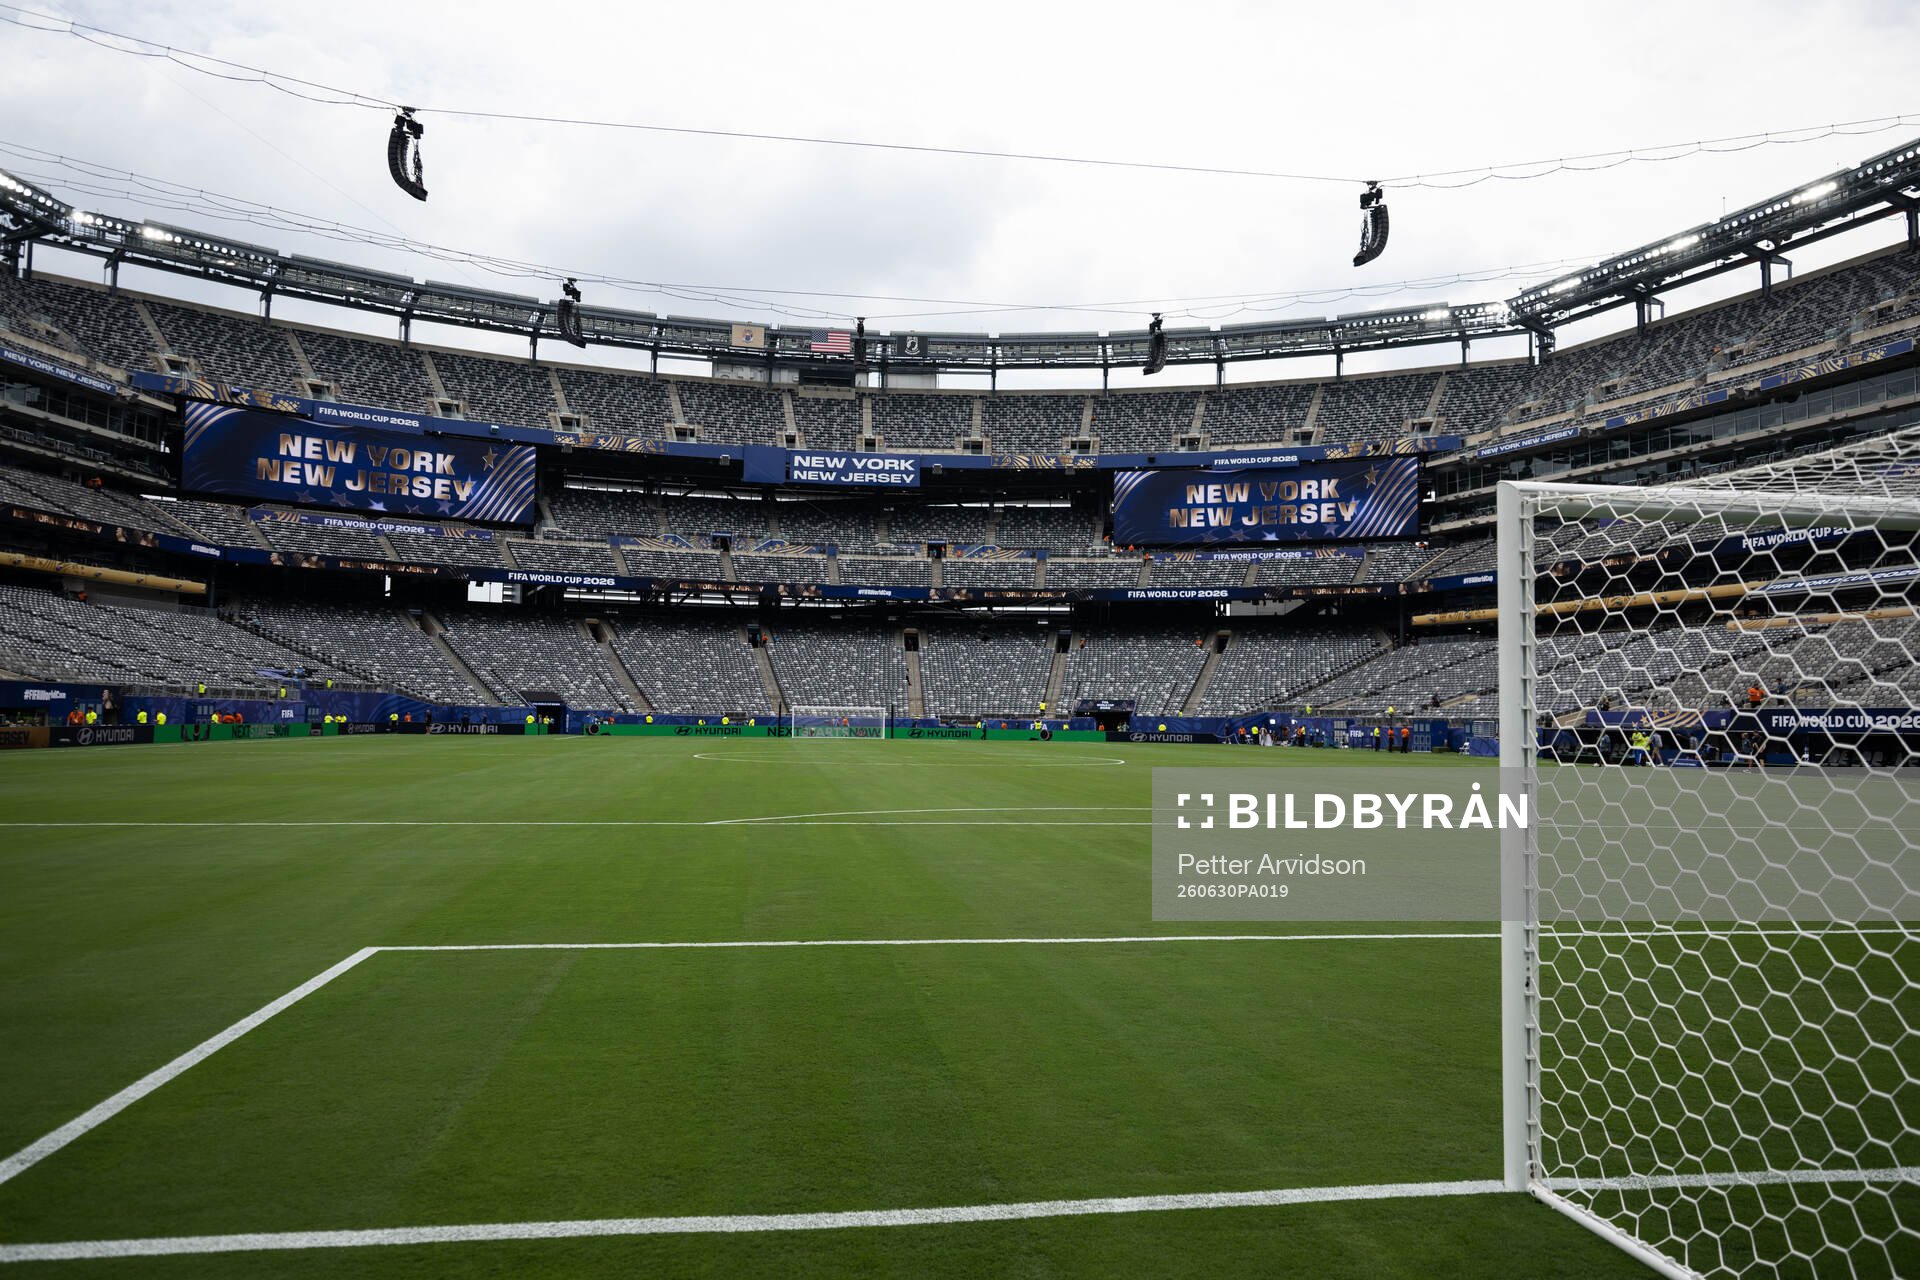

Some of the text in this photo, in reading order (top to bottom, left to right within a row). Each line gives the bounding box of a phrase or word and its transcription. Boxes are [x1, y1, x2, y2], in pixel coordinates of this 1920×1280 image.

[4, 350, 111, 390] NEW YORK NEW JERSEY
[319, 407, 338, 416] FIFA
[340, 410, 371, 420] WORLD
[390, 417, 419, 427] 2026
[1500, 443, 1521, 452] YORK
[1522, 438, 1540, 446] NEW
[1541, 429, 1574, 442] JERSEY
[279, 433, 456, 476] NEW YORK
[794, 455, 915, 471] NEW YORK
[256, 458, 473, 502] NEW JERSEY
[794, 470, 915, 484] NEW JERSEY
[1186, 478, 1340, 504] NEW YORK
[1169, 501, 1357, 528] NEW JERSEY
[324, 518, 343, 526] FIFA
[344, 520, 376, 529] WORLD
[396, 525, 425, 533] 2026
[1742, 538, 1766, 549] FIFA
[1767, 532, 1807, 545] WORLD
[1808, 527, 1831, 538] CUP
[508, 572, 615, 586] FIFA WORLD CUP 2026
[282, 710, 293, 718] FIFA
[1772, 716, 1796, 728] FIFA
[1799, 715, 1844, 728] WORLD
[1846, 715, 1873, 728] CUP
[96, 728, 134, 742] HYUNDAI
[696, 727, 741, 735] HYUNDAI
[767, 726, 800, 737] NEXT
[927, 730, 972, 739] HYUNDAI
[1148, 734, 1193, 743] HYUNDAI
